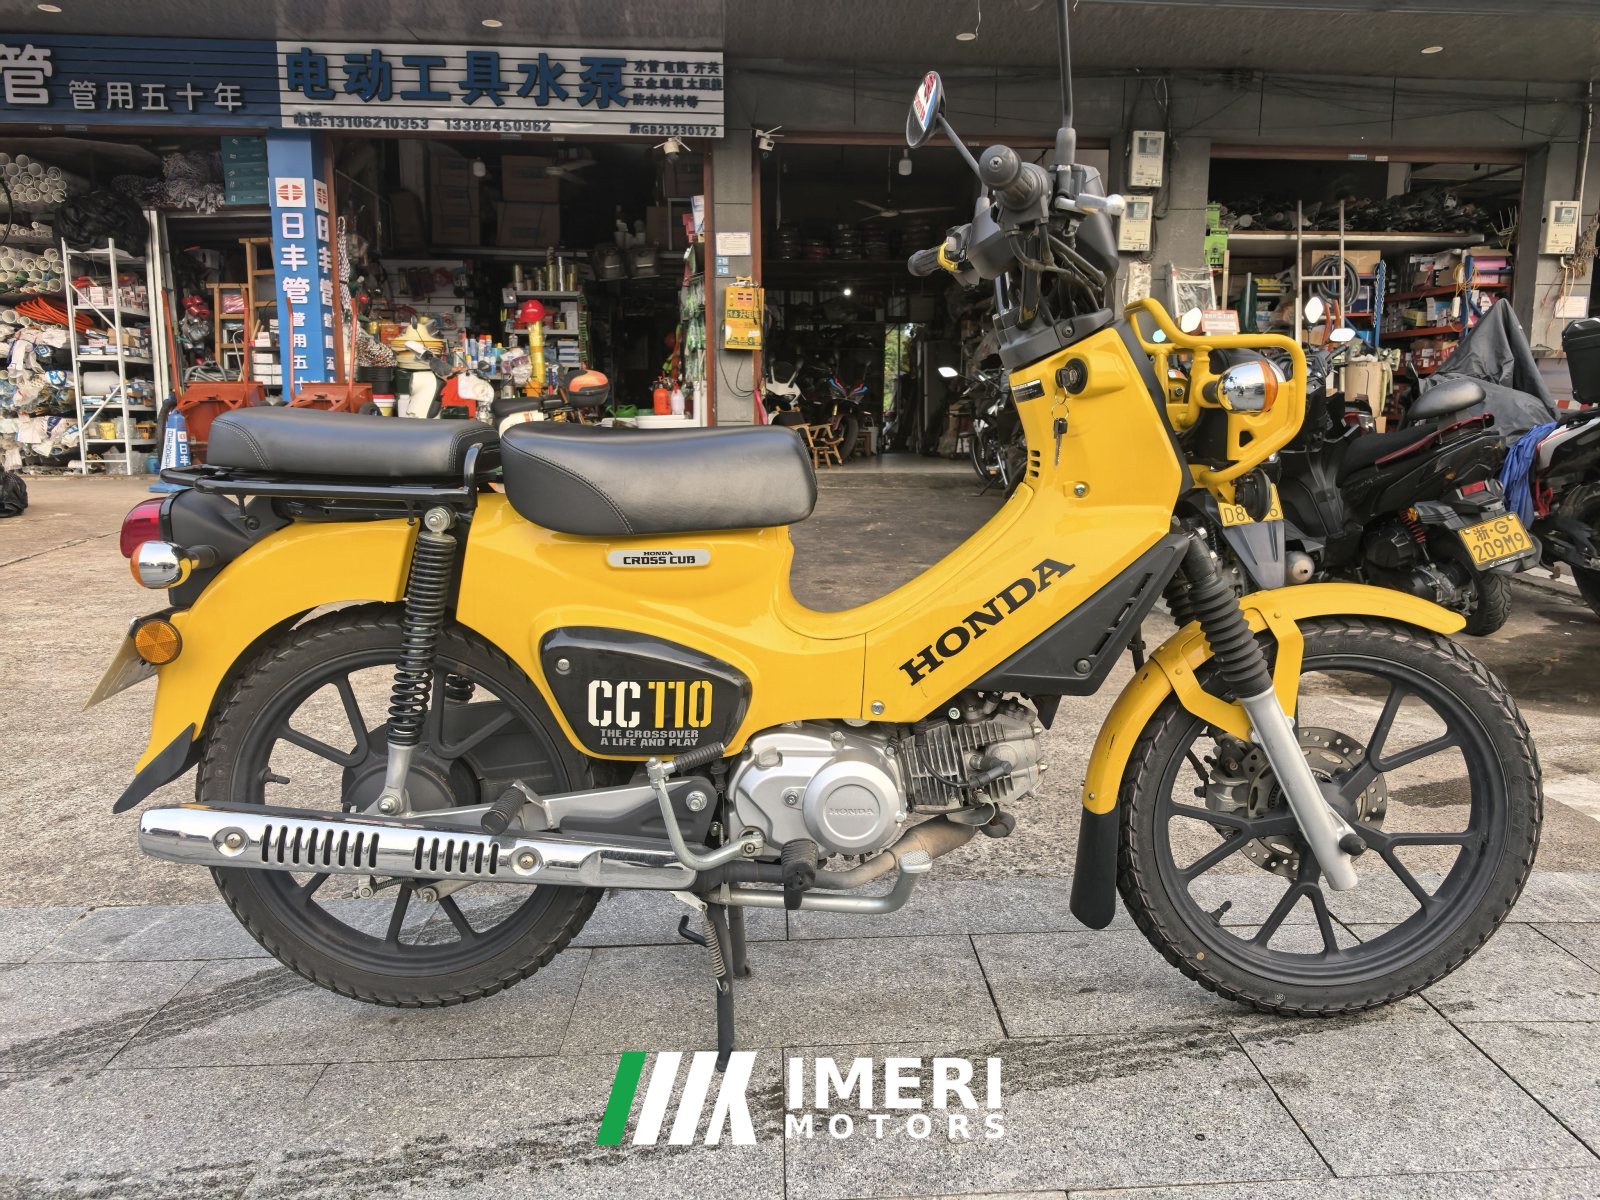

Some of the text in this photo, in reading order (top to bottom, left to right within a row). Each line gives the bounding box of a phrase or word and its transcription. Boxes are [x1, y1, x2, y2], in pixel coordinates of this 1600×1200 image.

[0, 43, 53, 104] 管
[285, 47, 629, 109] 电动工具水泵
[68, 79, 244, 112] 管用五十年
[280, 212, 311, 305] 日丰管
[623, 555, 696, 565] CROSS CUB
[1473, 532, 1525, 562] 209M9
[898, 558, 1077, 687] HONDA
[588, 679, 713, 729] CC 110
[600, 729, 699, 739] THE CROSSOVER
[600, 737, 699, 748] A LIFE AND PLAY
[828, 807, 875, 816] HONDA
